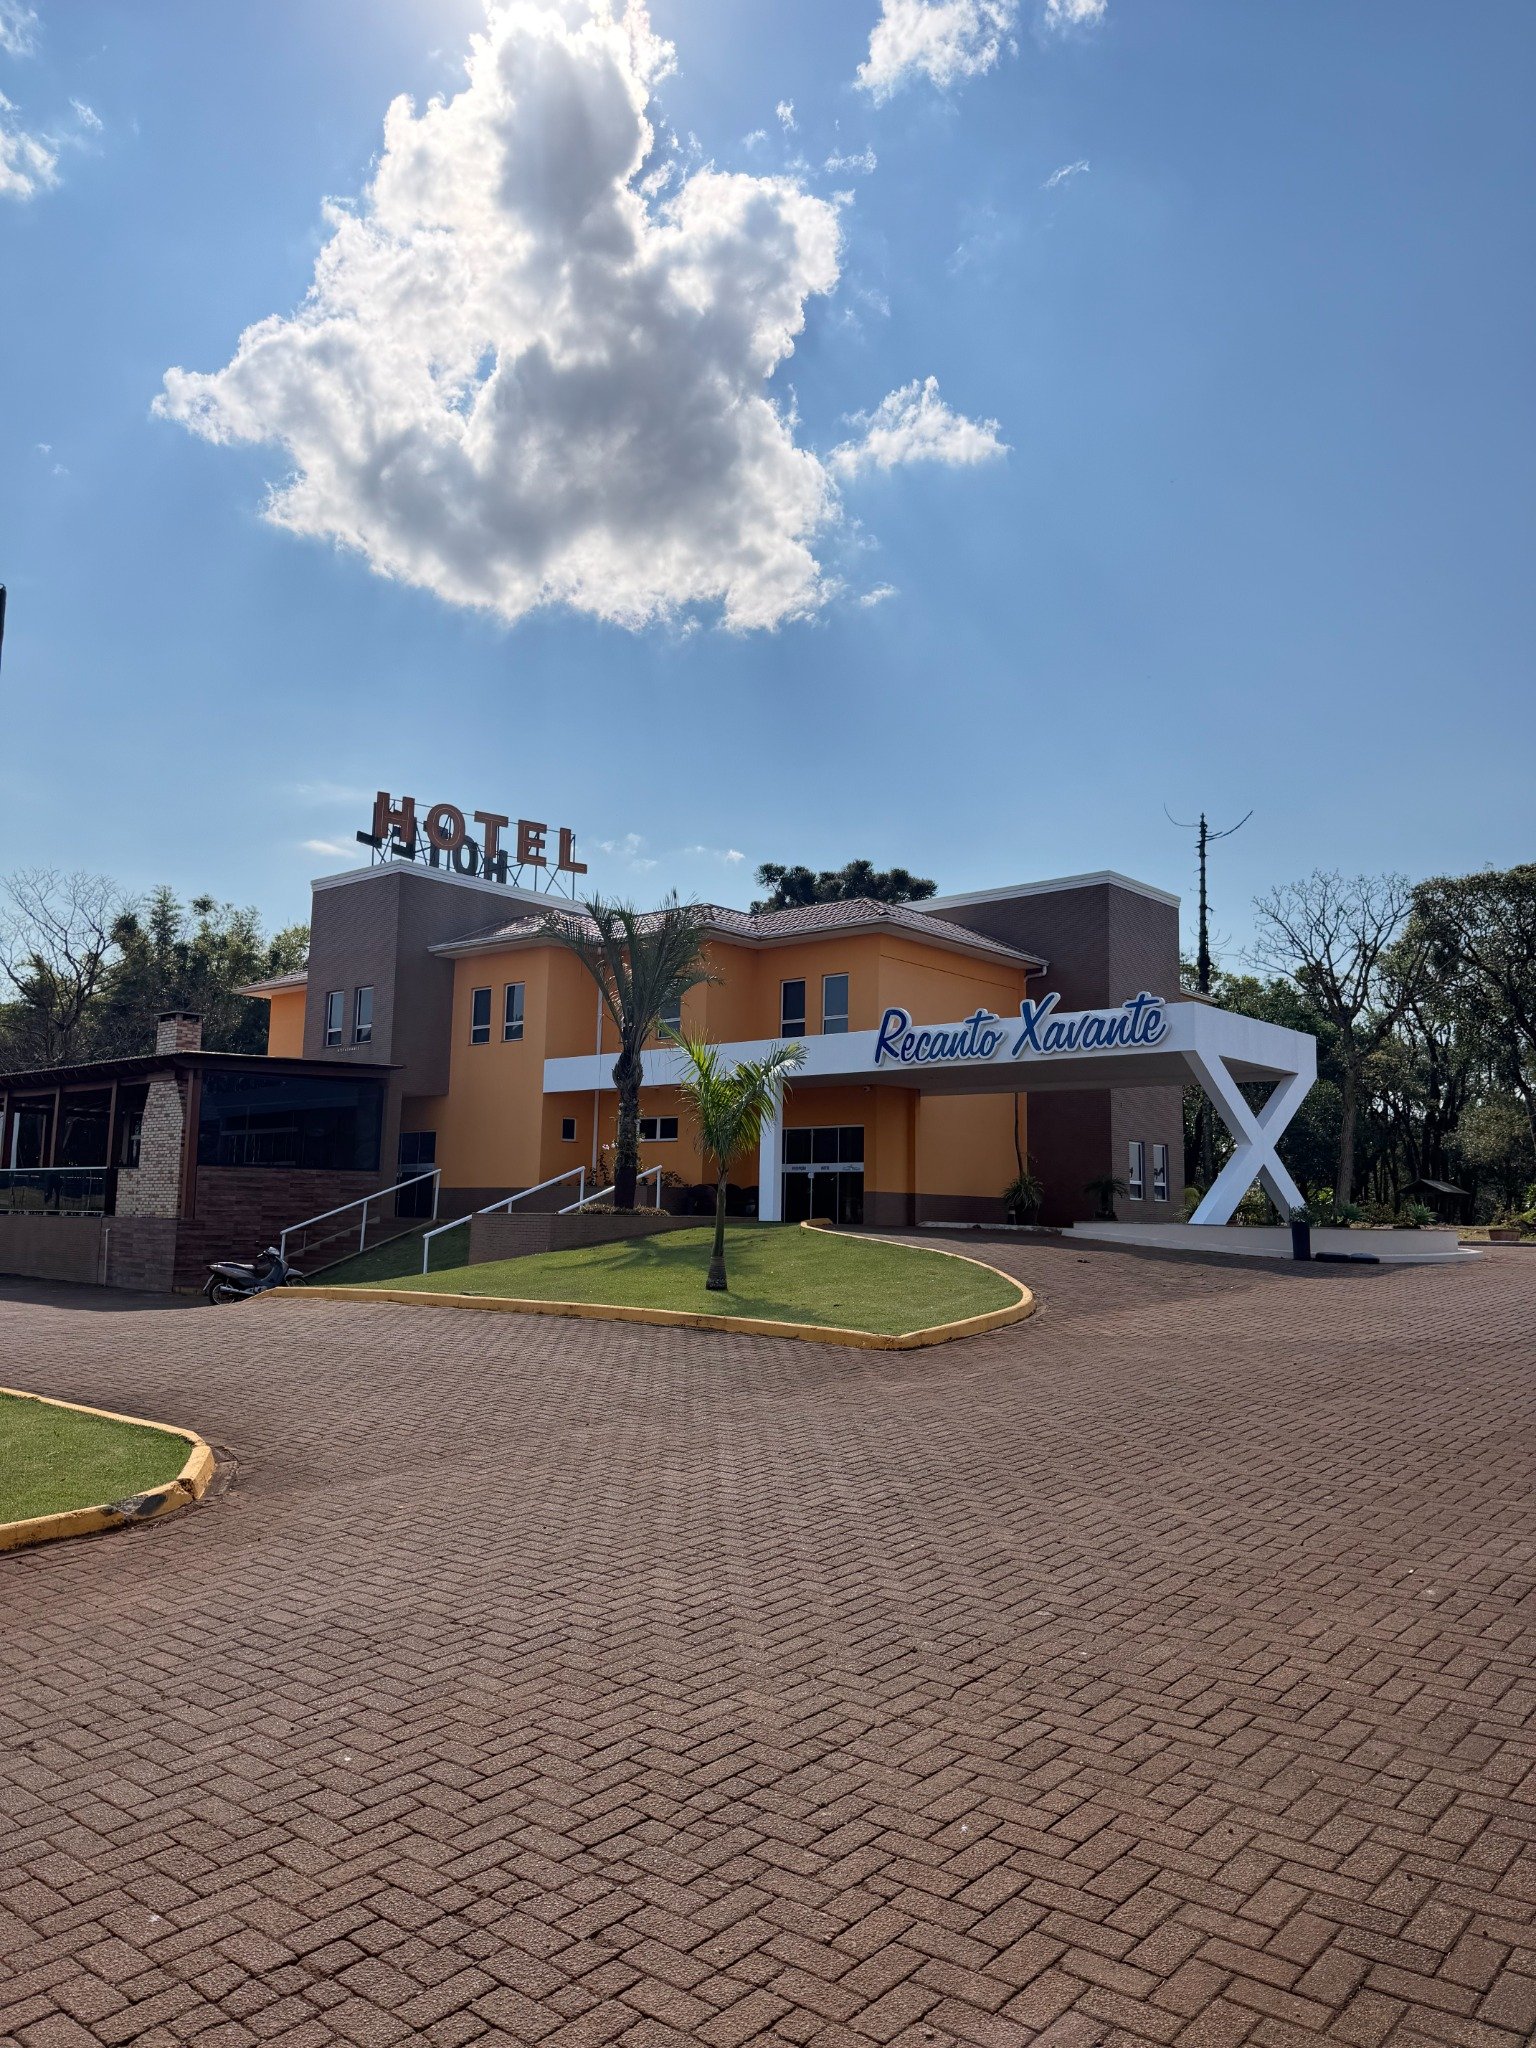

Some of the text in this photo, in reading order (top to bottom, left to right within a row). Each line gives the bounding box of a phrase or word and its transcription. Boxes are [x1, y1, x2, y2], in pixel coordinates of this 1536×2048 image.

[375, 791, 587, 874] HOTEL
[874, 991, 1168, 1065] Recanto Xavante
